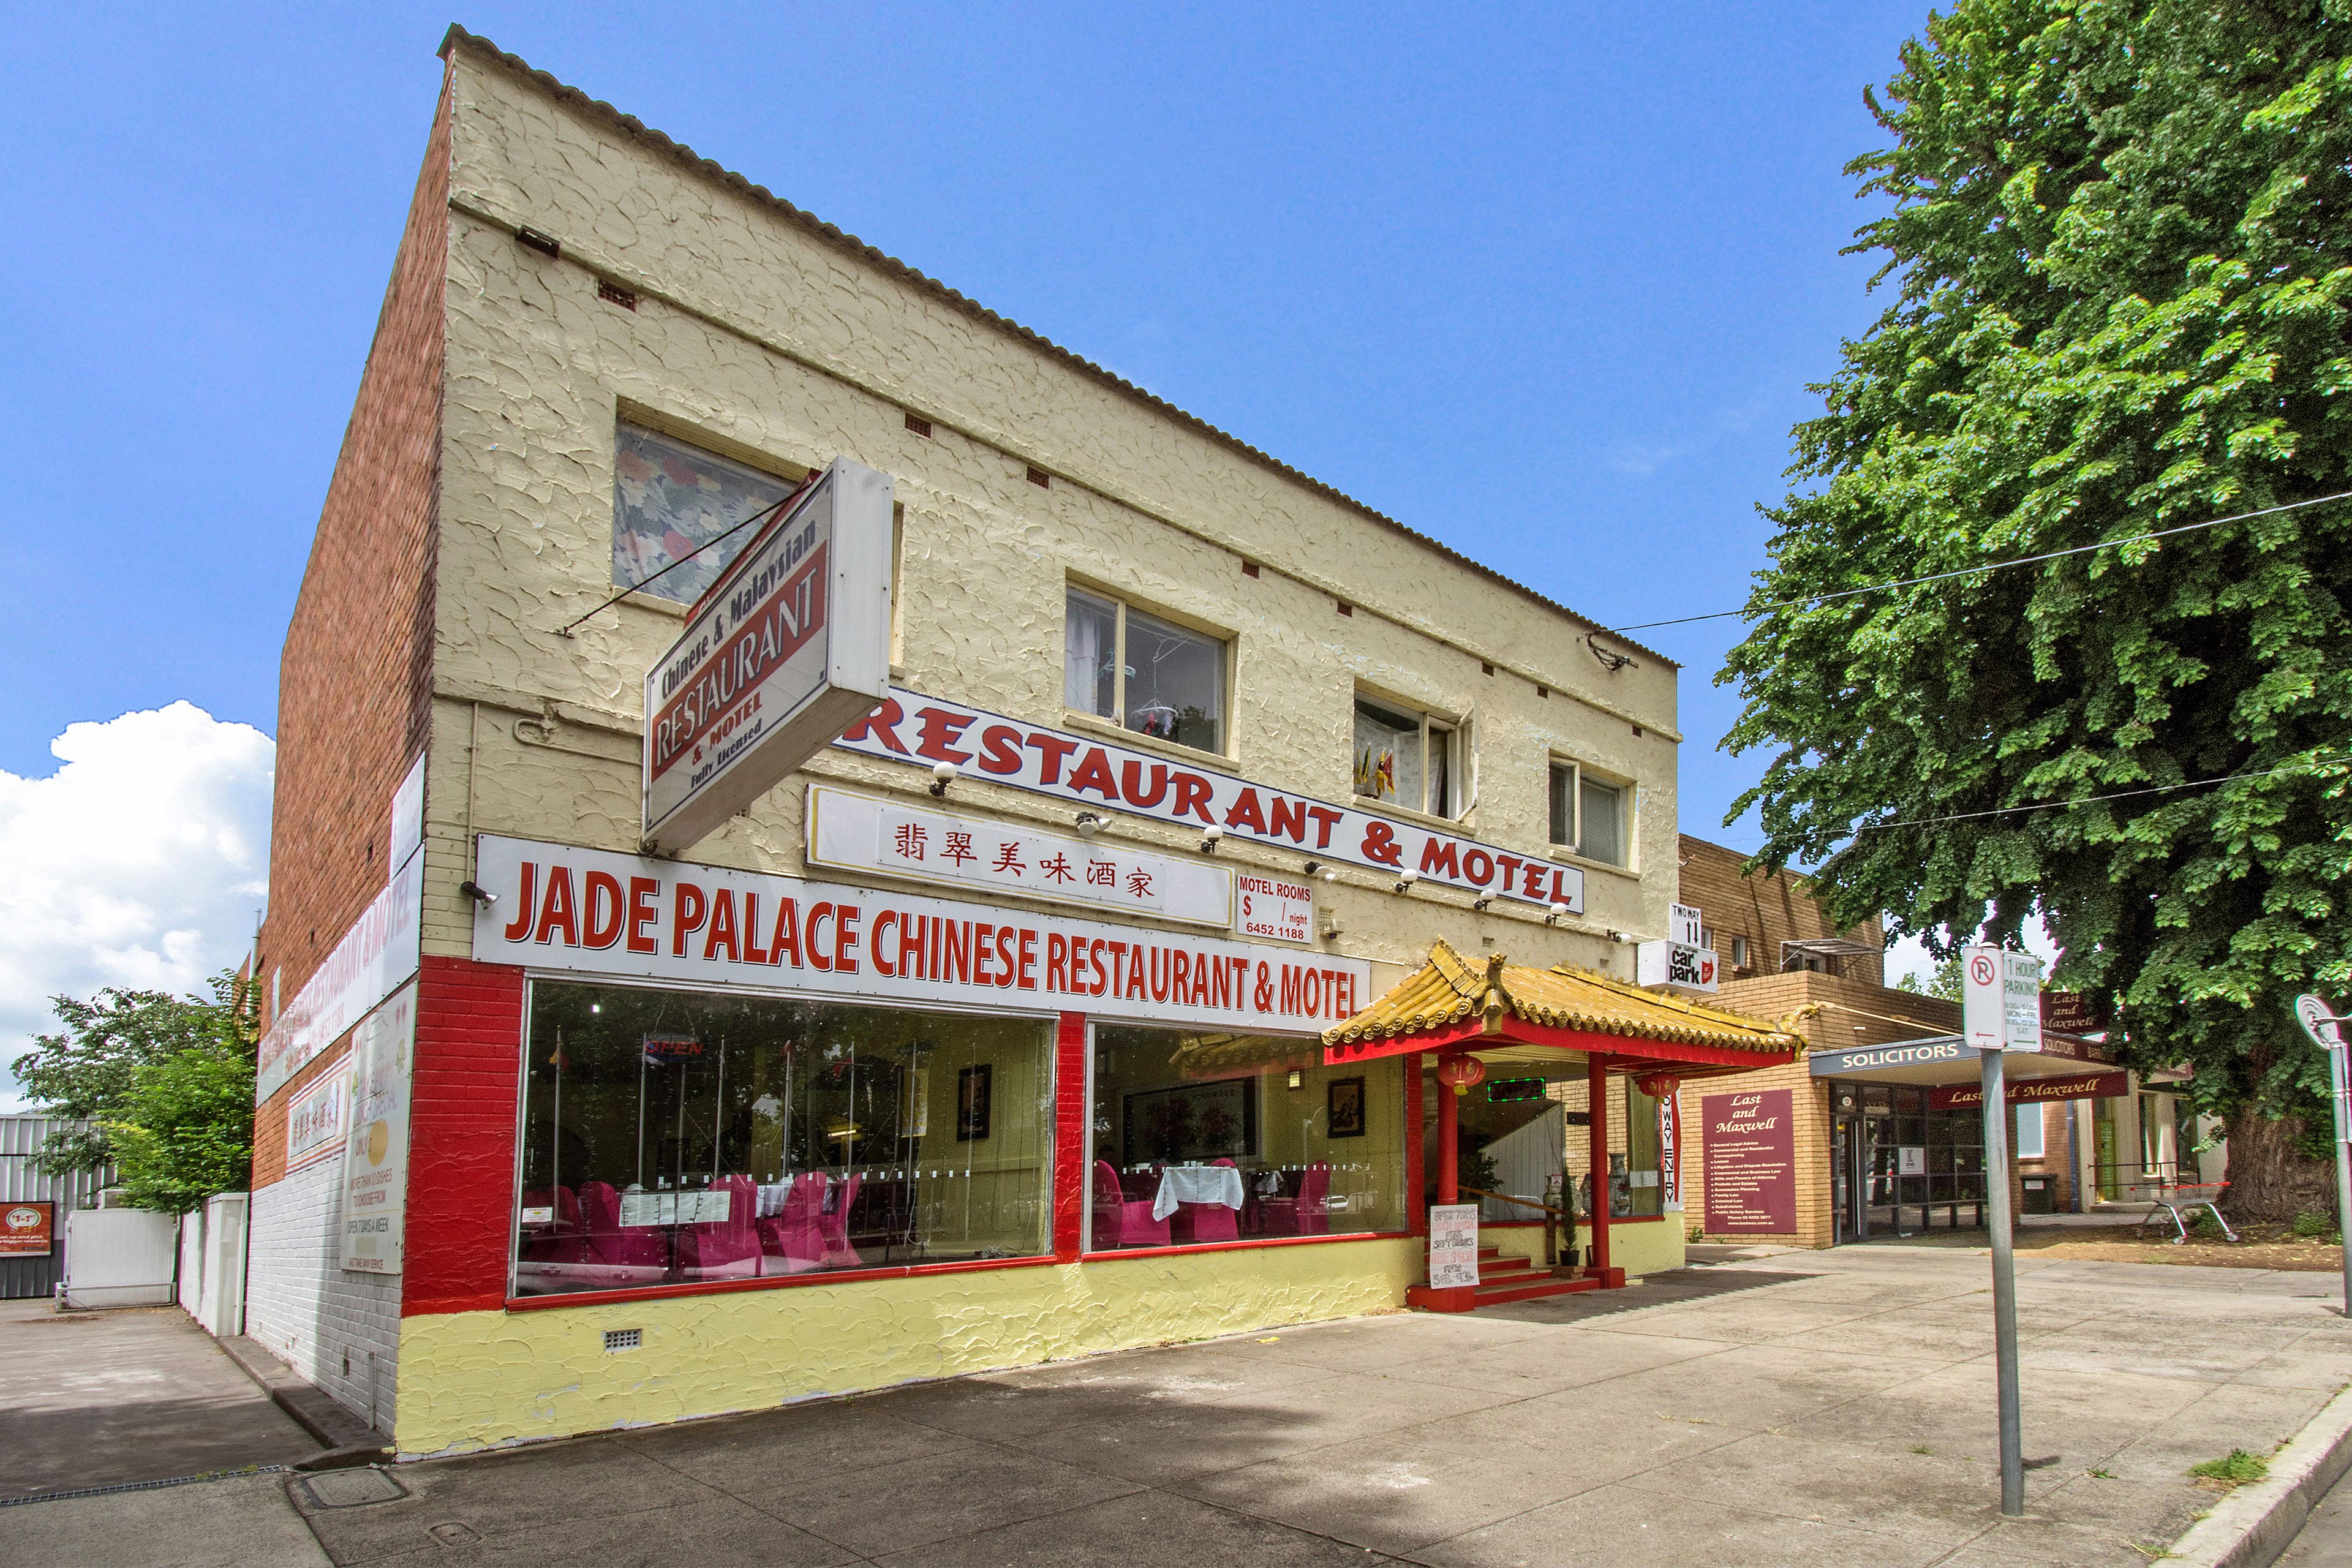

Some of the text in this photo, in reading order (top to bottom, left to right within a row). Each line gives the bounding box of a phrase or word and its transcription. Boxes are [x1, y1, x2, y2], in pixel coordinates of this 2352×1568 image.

[662, 521, 815, 699] Chinese & Malaysian
[657, 568, 818, 767] RESTAURANT
[692, 691, 763, 766] & MOTEL
[690, 718, 762, 788] Fully Licensed
[842, 696, 1572, 905] RESTAURANT & MOTEL
[894, 823, 1155, 899] 翡翠美味酒家
[1240, 876, 1311, 902] MOTEL ROOMS
[1243, 894, 1251, 918] $
[1673, 905, 1700, 919] TWO WAY
[1246, 922, 1303, 939] 6452 1188
[505, 861, 1356, 1020] JADE PALACE CHINESE RESTAURANT & MOTEL
[1672, 950, 1694, 967] car
[1669, 965, 1700, 984] park
[2008, 959, 2036, 978] 1 HOUR
[2004, 980, 2037, 997] PARKING
[2051, 995, 2081, 1005] Last
[2053, 1005, 2078, 1016] and
[644, 1039, 704, 1054] OPEN
[1842, 1043, 1959, 1068] SOLICITORS
[2023, 1079, 2100, 1097] Maxwell
[1730, 1095, 1762, 1106] Last
[1732, 1106, 1759, 1118] and
[1663, 1111, 1672, 1143] WAY
[1716, 1117, 1777, 1133] Maxwell
[1664, 1149, 1673, 1203] ENTRY
